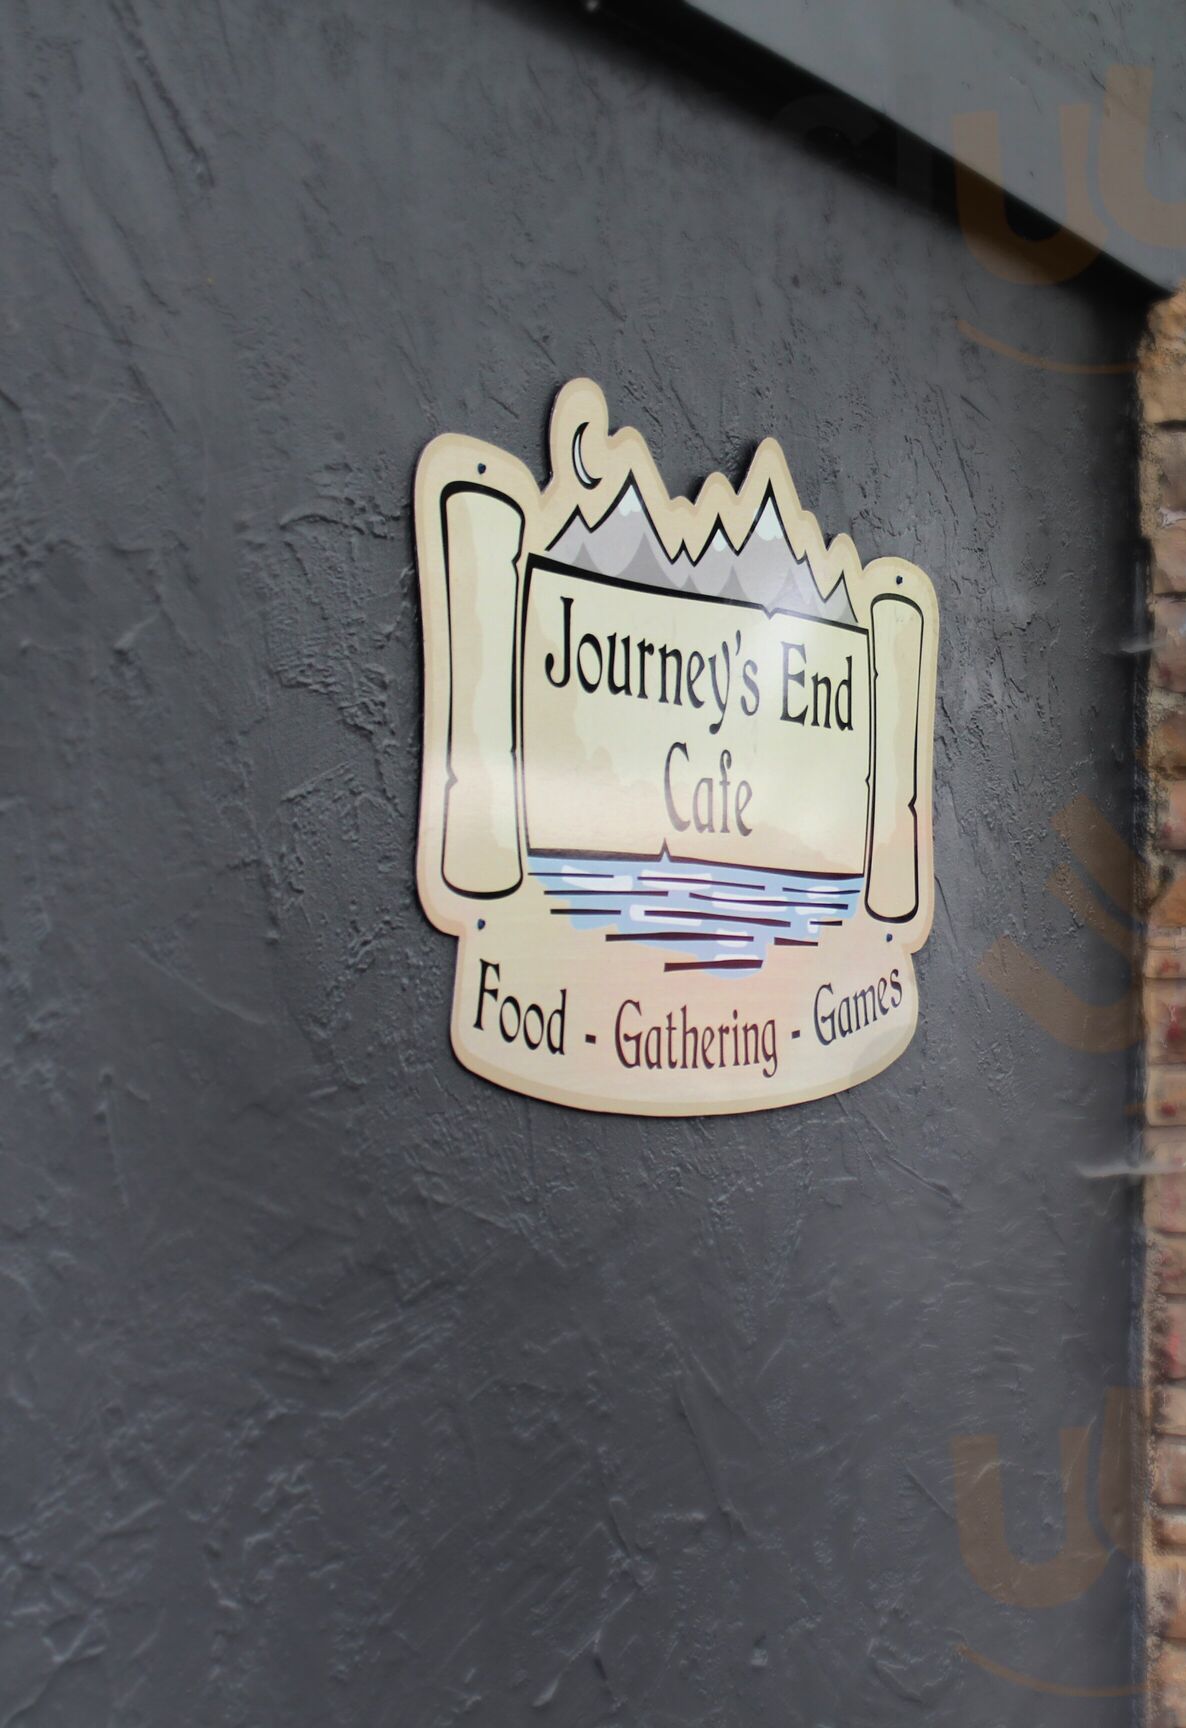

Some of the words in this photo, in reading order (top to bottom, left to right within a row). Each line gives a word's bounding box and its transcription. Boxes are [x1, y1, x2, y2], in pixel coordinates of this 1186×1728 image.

[544, 595, 760, 735] Journey's
[779, 641, 854, 731] End
[663, 742, 753, 836] Cafe
[473, 959, 567, 1055] Food
[614, 999, 778, 1078] Gathering
[813, 967, 903, 1046] Games
